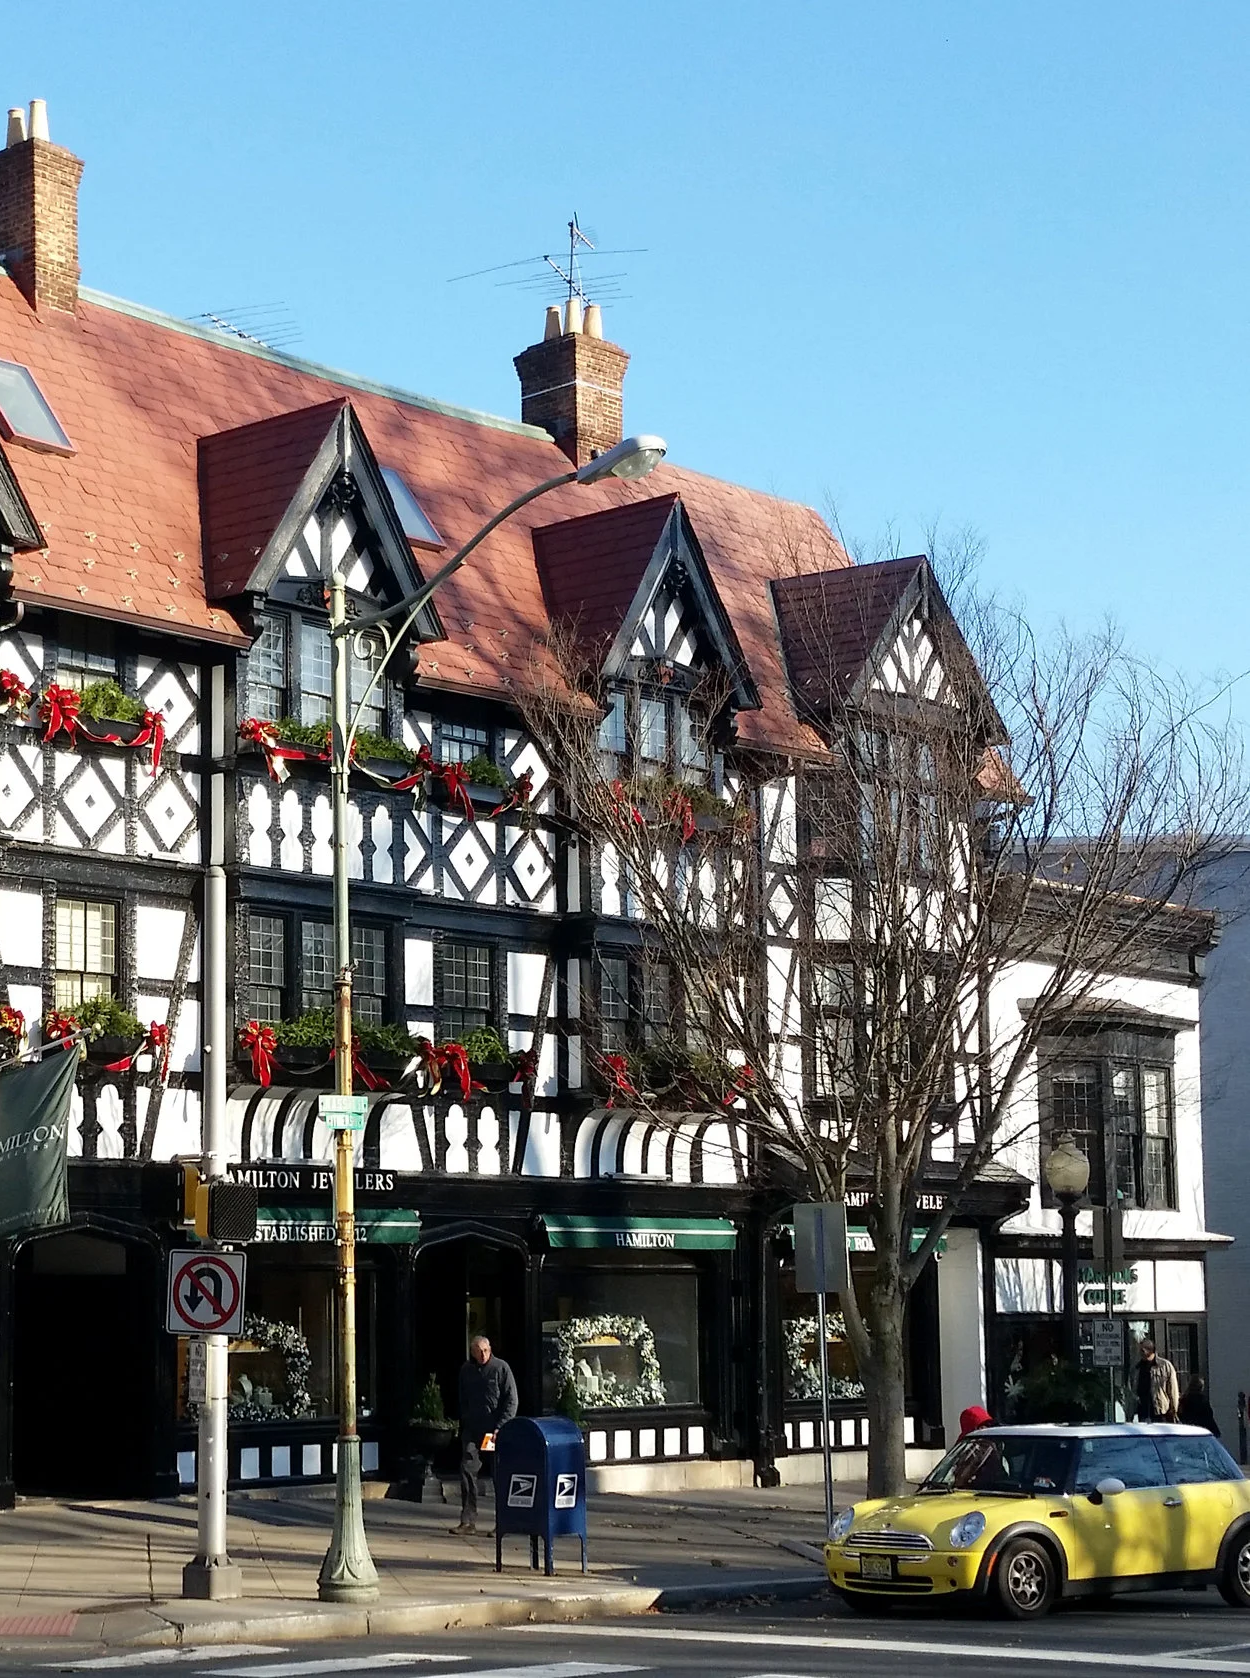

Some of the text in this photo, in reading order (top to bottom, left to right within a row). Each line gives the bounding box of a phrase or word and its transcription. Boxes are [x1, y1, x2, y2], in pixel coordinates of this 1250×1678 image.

[228, 1169, 394, 1191] AMILTON JELERS
[254, 1225, 337, 1242] STABLISHED
[615, 1233, 675, 1248] HAMILTON
[1102, 1322, 1114, 1333] NO
